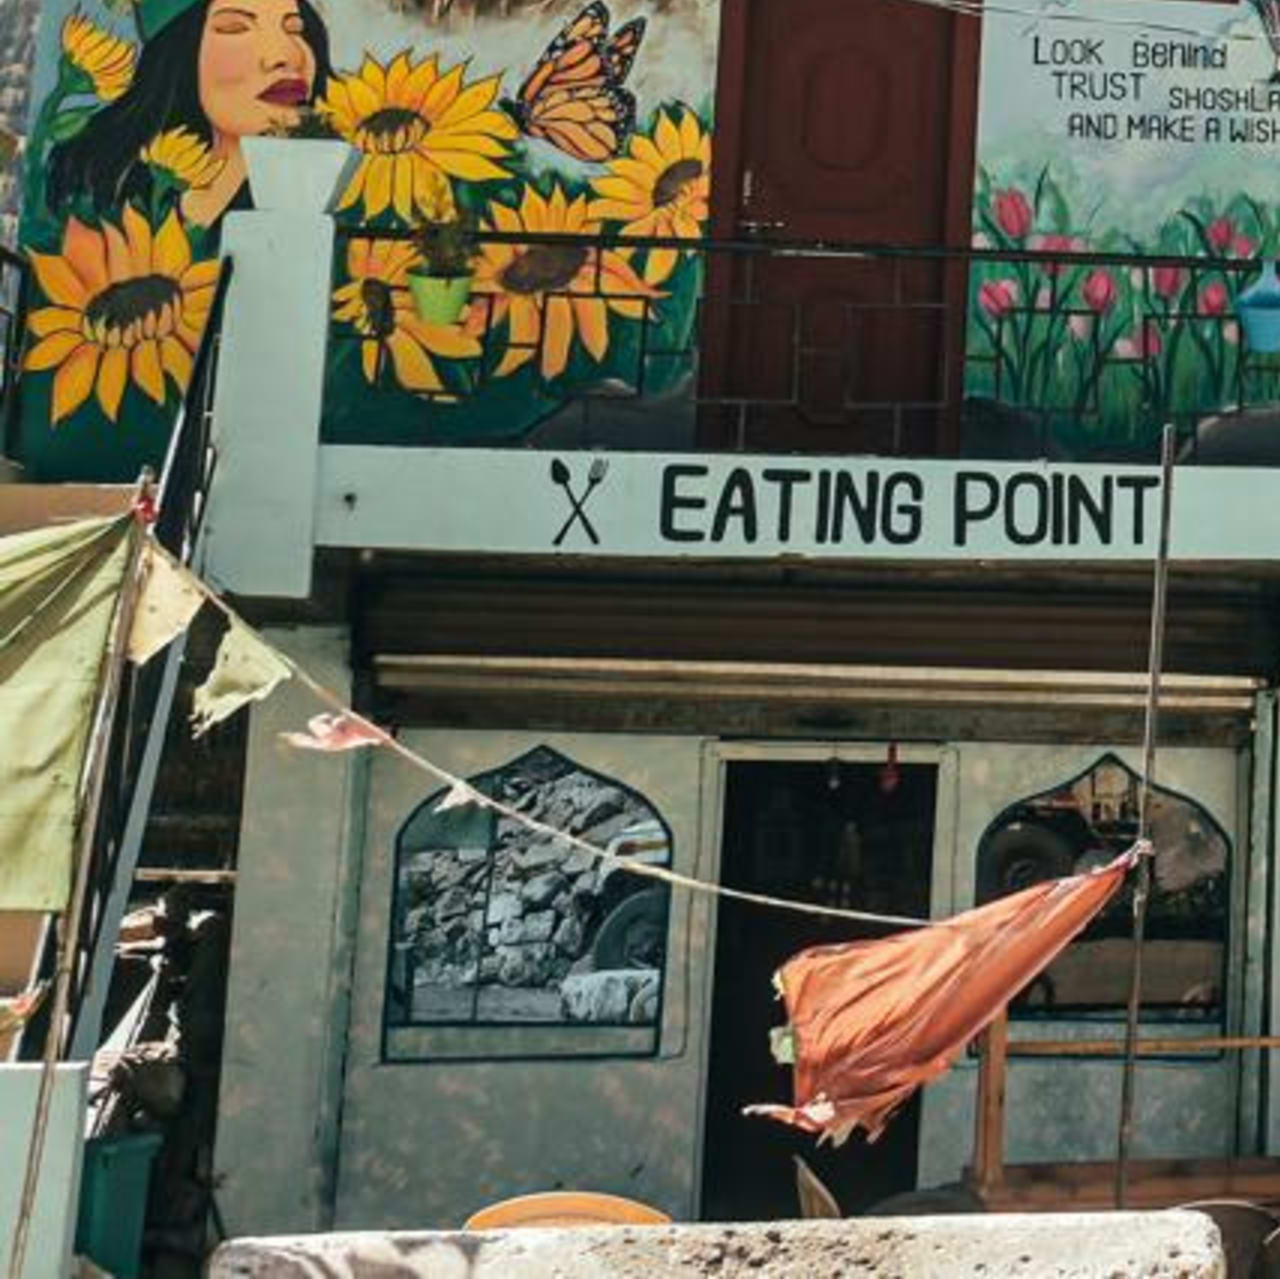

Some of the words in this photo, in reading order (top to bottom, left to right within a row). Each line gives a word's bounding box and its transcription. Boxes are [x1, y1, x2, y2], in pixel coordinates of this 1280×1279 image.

[1032, 36, 1104, 66] LOOK
[1052, 71, 1146, 102] TRUST
[1067, 112, 1118, 140] AND
[1126, 114, 1195, 142] MAKE
[1203, 116, 1222, 142] A
[659, 464, 923, 544] EATING
[953, 471, 1160, 546] POINT
